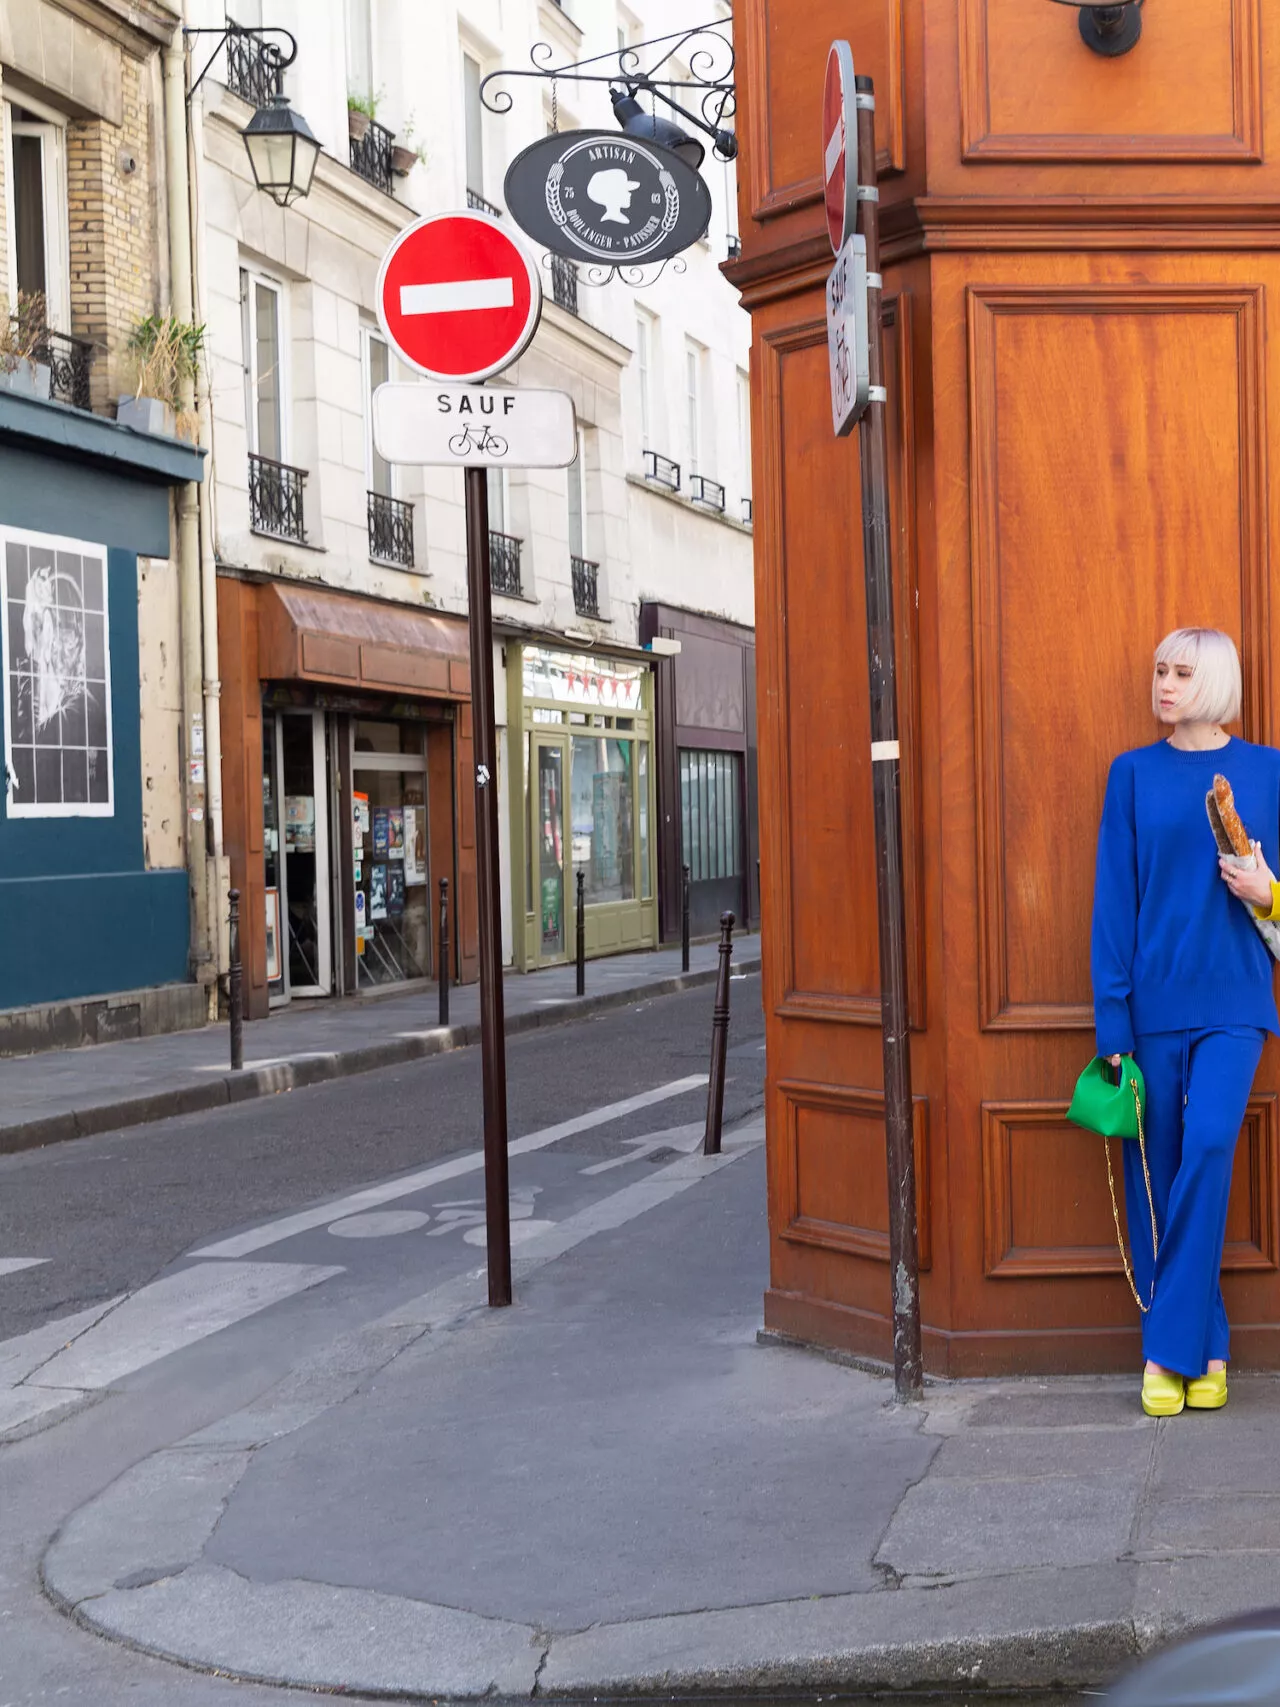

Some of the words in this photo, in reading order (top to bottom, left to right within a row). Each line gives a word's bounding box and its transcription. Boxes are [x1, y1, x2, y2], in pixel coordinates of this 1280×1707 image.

[588, 145, 636, 165] ARTISAN
[564, 186, 575, 199] 75
[651, 192, 661, 205] 03
[566, 208, 613, 249] BOULANGER
[437, 394, 516, 415] SAUF
